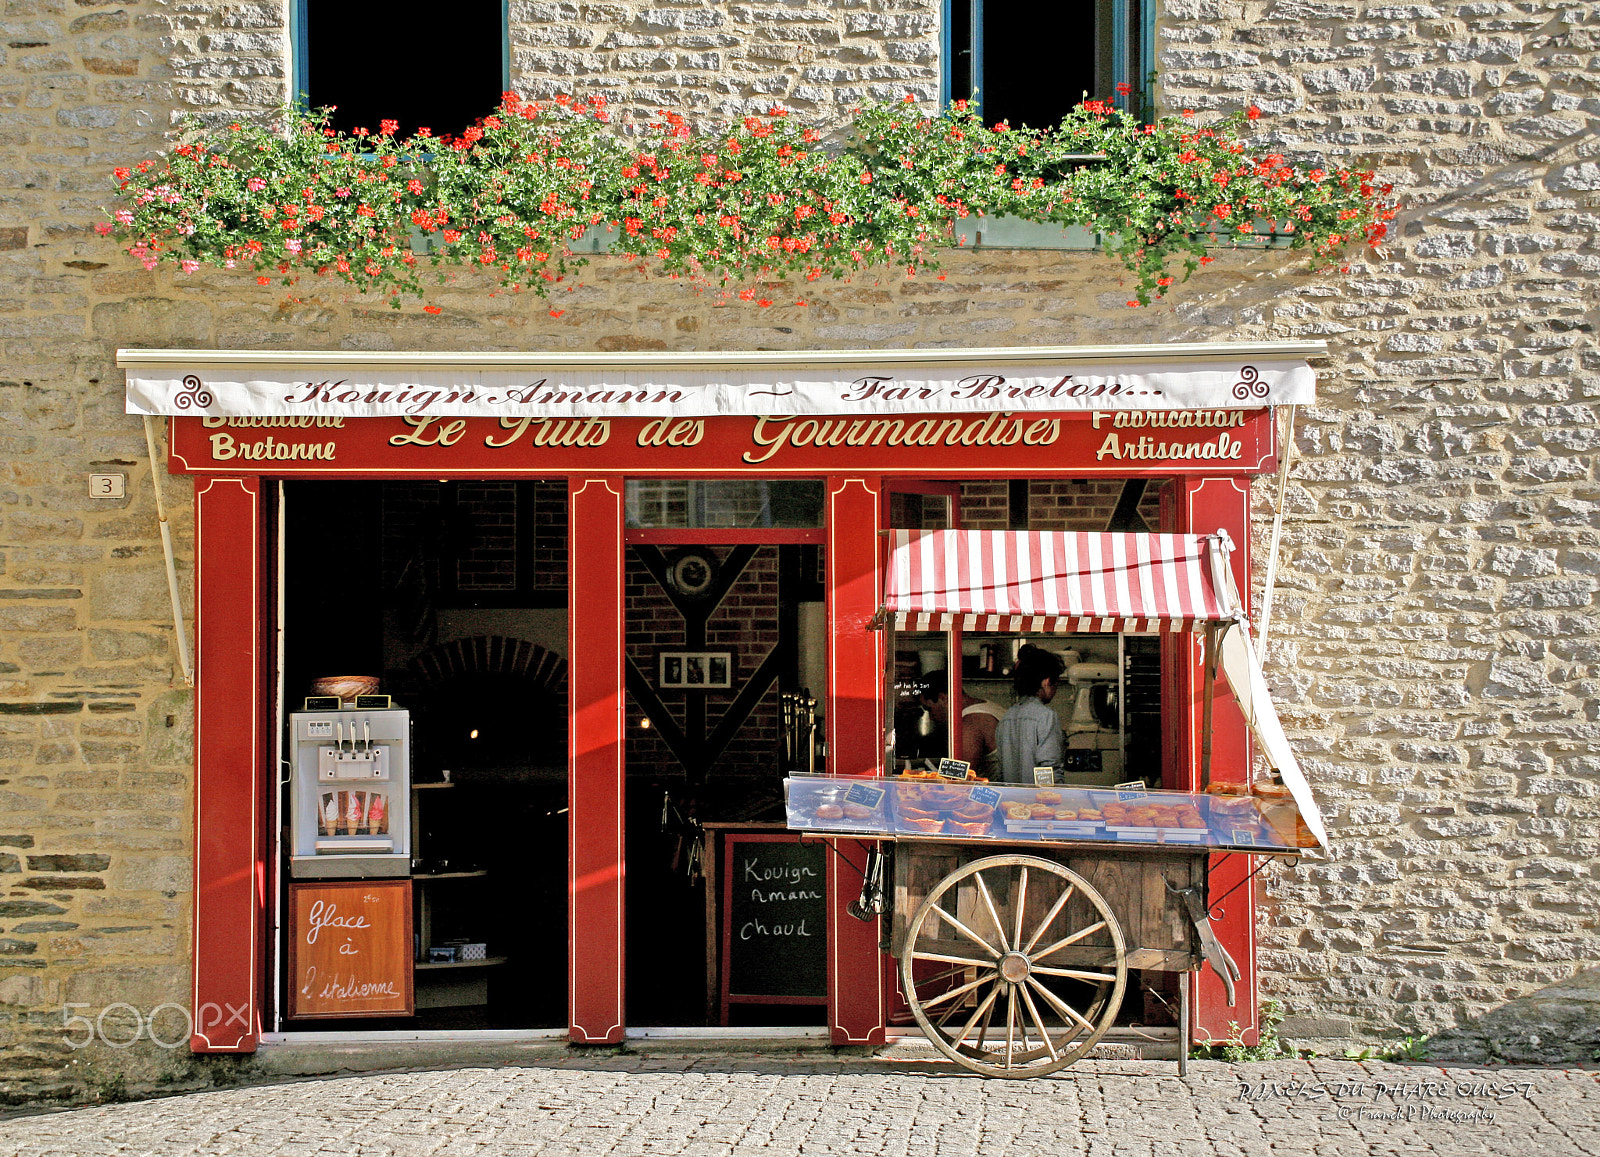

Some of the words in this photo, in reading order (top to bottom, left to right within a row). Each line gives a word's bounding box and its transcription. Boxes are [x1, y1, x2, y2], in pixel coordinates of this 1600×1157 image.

[284, 379, 487, 414] Kouign
[487, 379, 695, 404] Amann
[841, 376, 943, 401] Far
[208, 432, 337, 461] Bretonne
[388, 415, 467, 446] Le
[636, 416, 706, 447] des
[742, 411, 1062, 463] Gourmandises
[1095, 431, 1243, 461] Artisanale
[101, 478, 113, 494] 3
[744, 857, 817, 884] Kouign
[751, 888, 822, 903] Amann
[306, 900, 371, 945] Glace
[740, 918, 812, 941] Chaud
[339, 937, 359, 955] à
